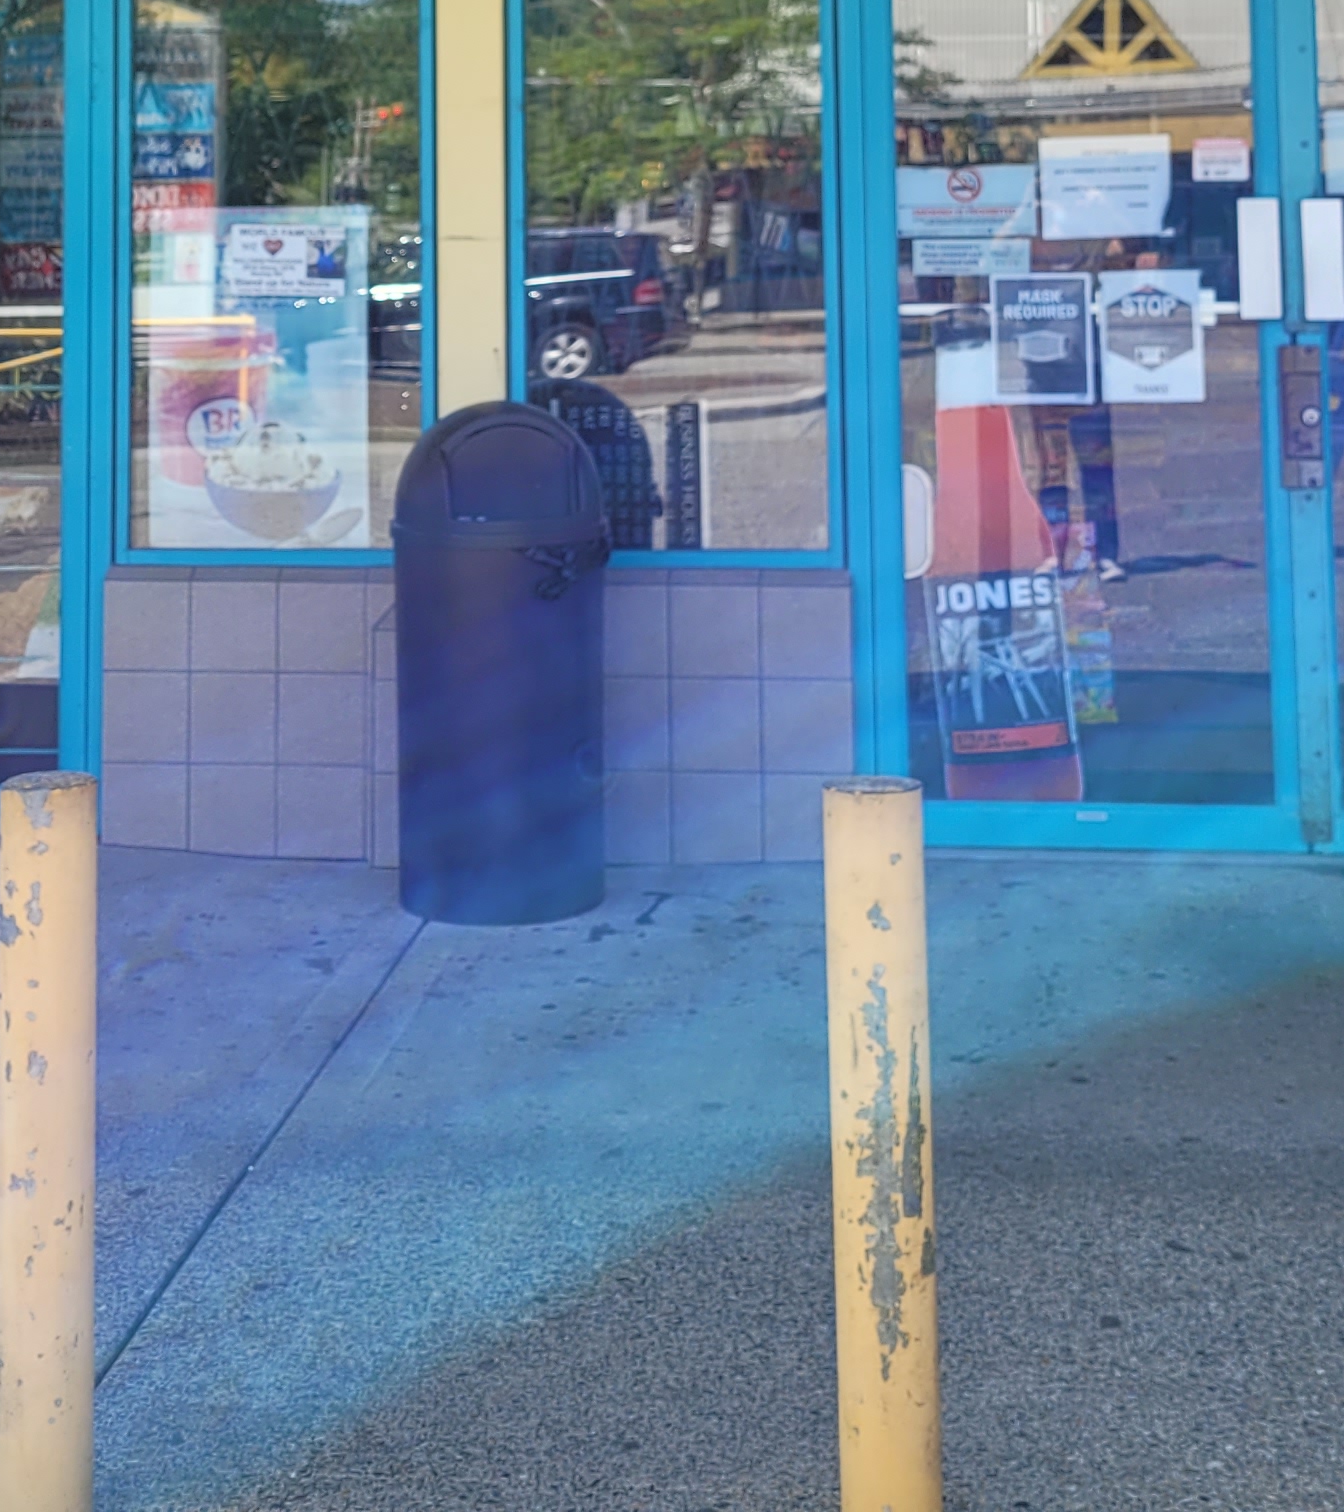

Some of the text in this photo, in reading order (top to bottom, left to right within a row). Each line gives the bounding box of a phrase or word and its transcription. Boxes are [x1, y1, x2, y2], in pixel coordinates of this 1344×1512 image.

[1017, 289, 1064, 304] MASK
[1120, 295, 1178, 318] STOP
[1003, 303, 1080, 321] REQUIRED
[934, 575, 1054, 615] JONES
